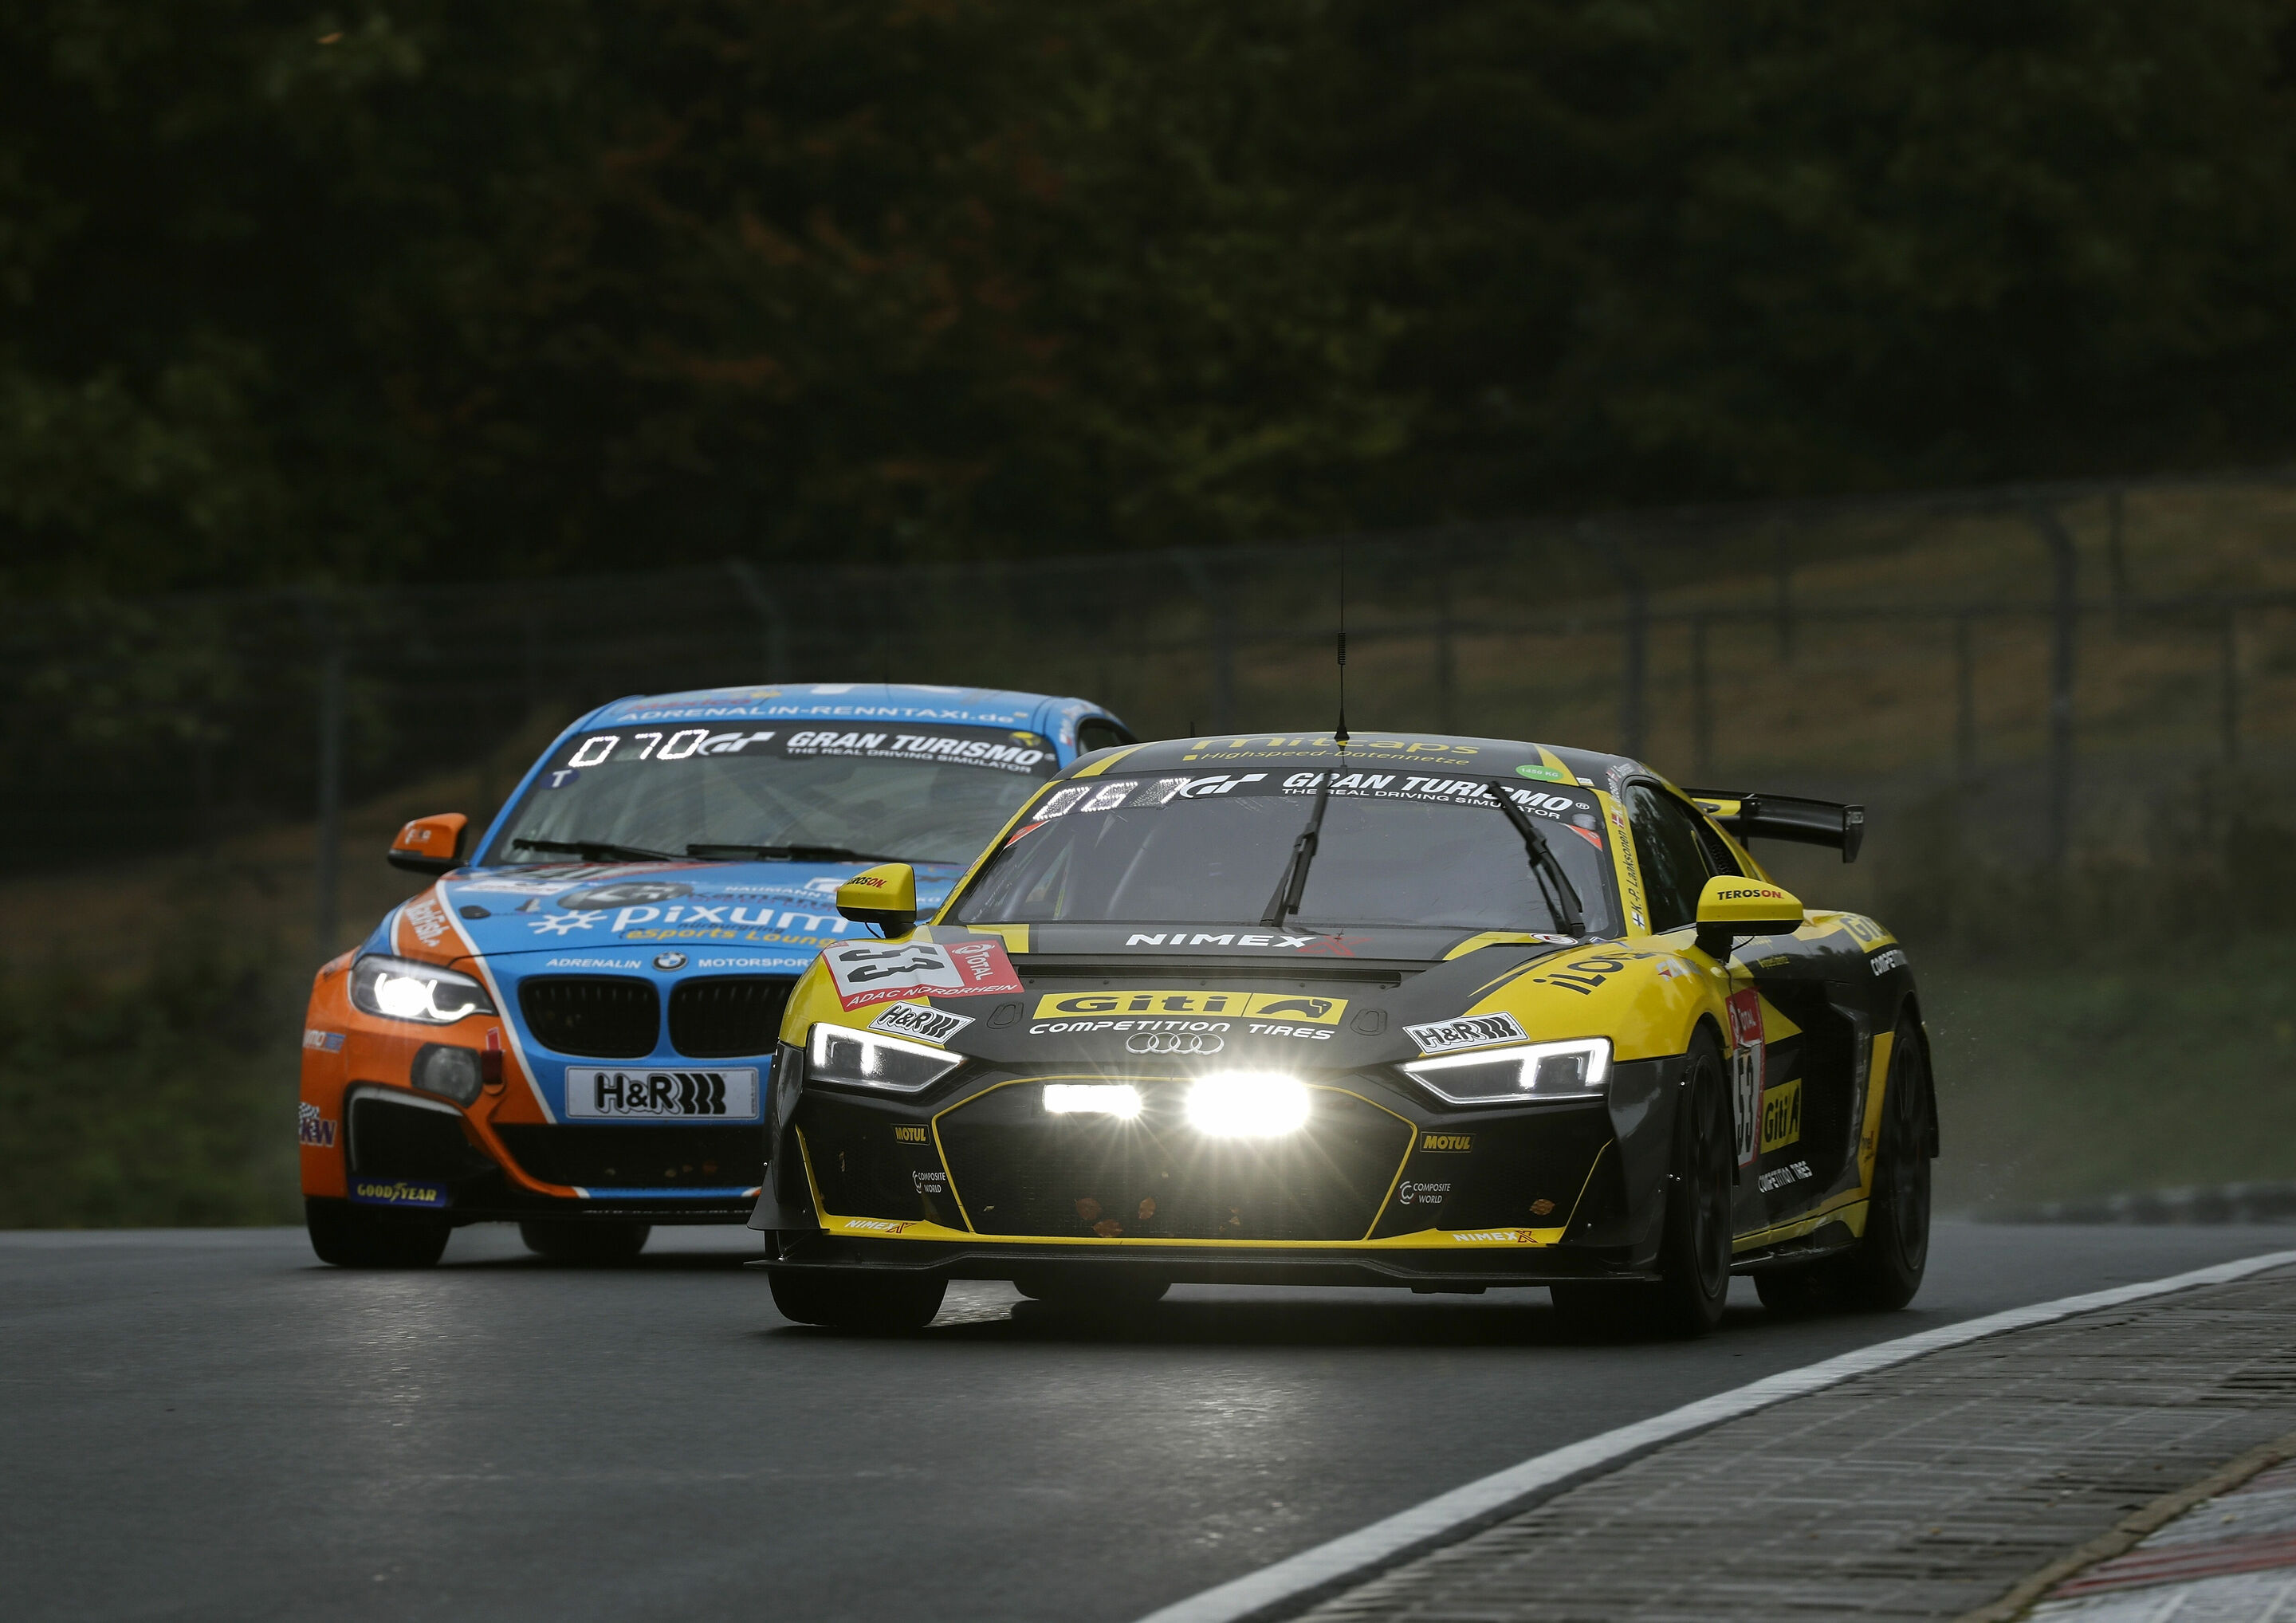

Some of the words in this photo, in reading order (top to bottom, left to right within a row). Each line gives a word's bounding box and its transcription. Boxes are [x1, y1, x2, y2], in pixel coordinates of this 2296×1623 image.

[568, 729, 710, 767] 070
[786, 731, 888, 749] GRAN
[890, 734, 1044, 766] TURISMO
[821, 747, 863, 756] REAL
[867, 749, 934, 761] DRIVING
[936, 754, 1032, 774] SIMULATOR
[552, 769, 572, 788] T
[1282, 772, 1397, 789] GRAN
[1374, 791, 1449, 801] DRIVING
[1455, 797, 1561, 819] SIMUTOR
[1717, 890, 1783, 901] TEROSON
[611, 905, 850, 933] pixum
[745, 931, 837, 949] Loung
[546, 958, 642, 969] ADRENALIN
[698, 957, 814, 969] MOTORSPOR
[839, 945, 945, 983] 53
[965, 953, 994, 981] TOTAL
[846, 990, 901, 1008] ADAC
[903, 984, 1018, 996] NORDRHEIN
[1056, 995, 1230, 1013] Giti
[877, 1005, 934, 1034] H&R
[1029, 1020, 1231, 1035] COMPETITION
[1249, 1024, 1335, 1039] TIRES
[1413, 1021, 1484, 1047] H&R
[596, 1071, 678, 1113] H&R
[1764, 1095, 1788, 1143] Giti
[895, 1126, 926, 1142] MOTUL
[1423, 1134, 1471, 1149] MOTUL
[918, 1171, 946, 1181] COMPOSITE
[357, 1183, 437, 1201] GOODYEAR
[924, 1184, 942, 1193] WORLD
[1413, 1183, 1451, 1192] COMPOSITE
[1419, 1195, 1442, 1204] WORLD
